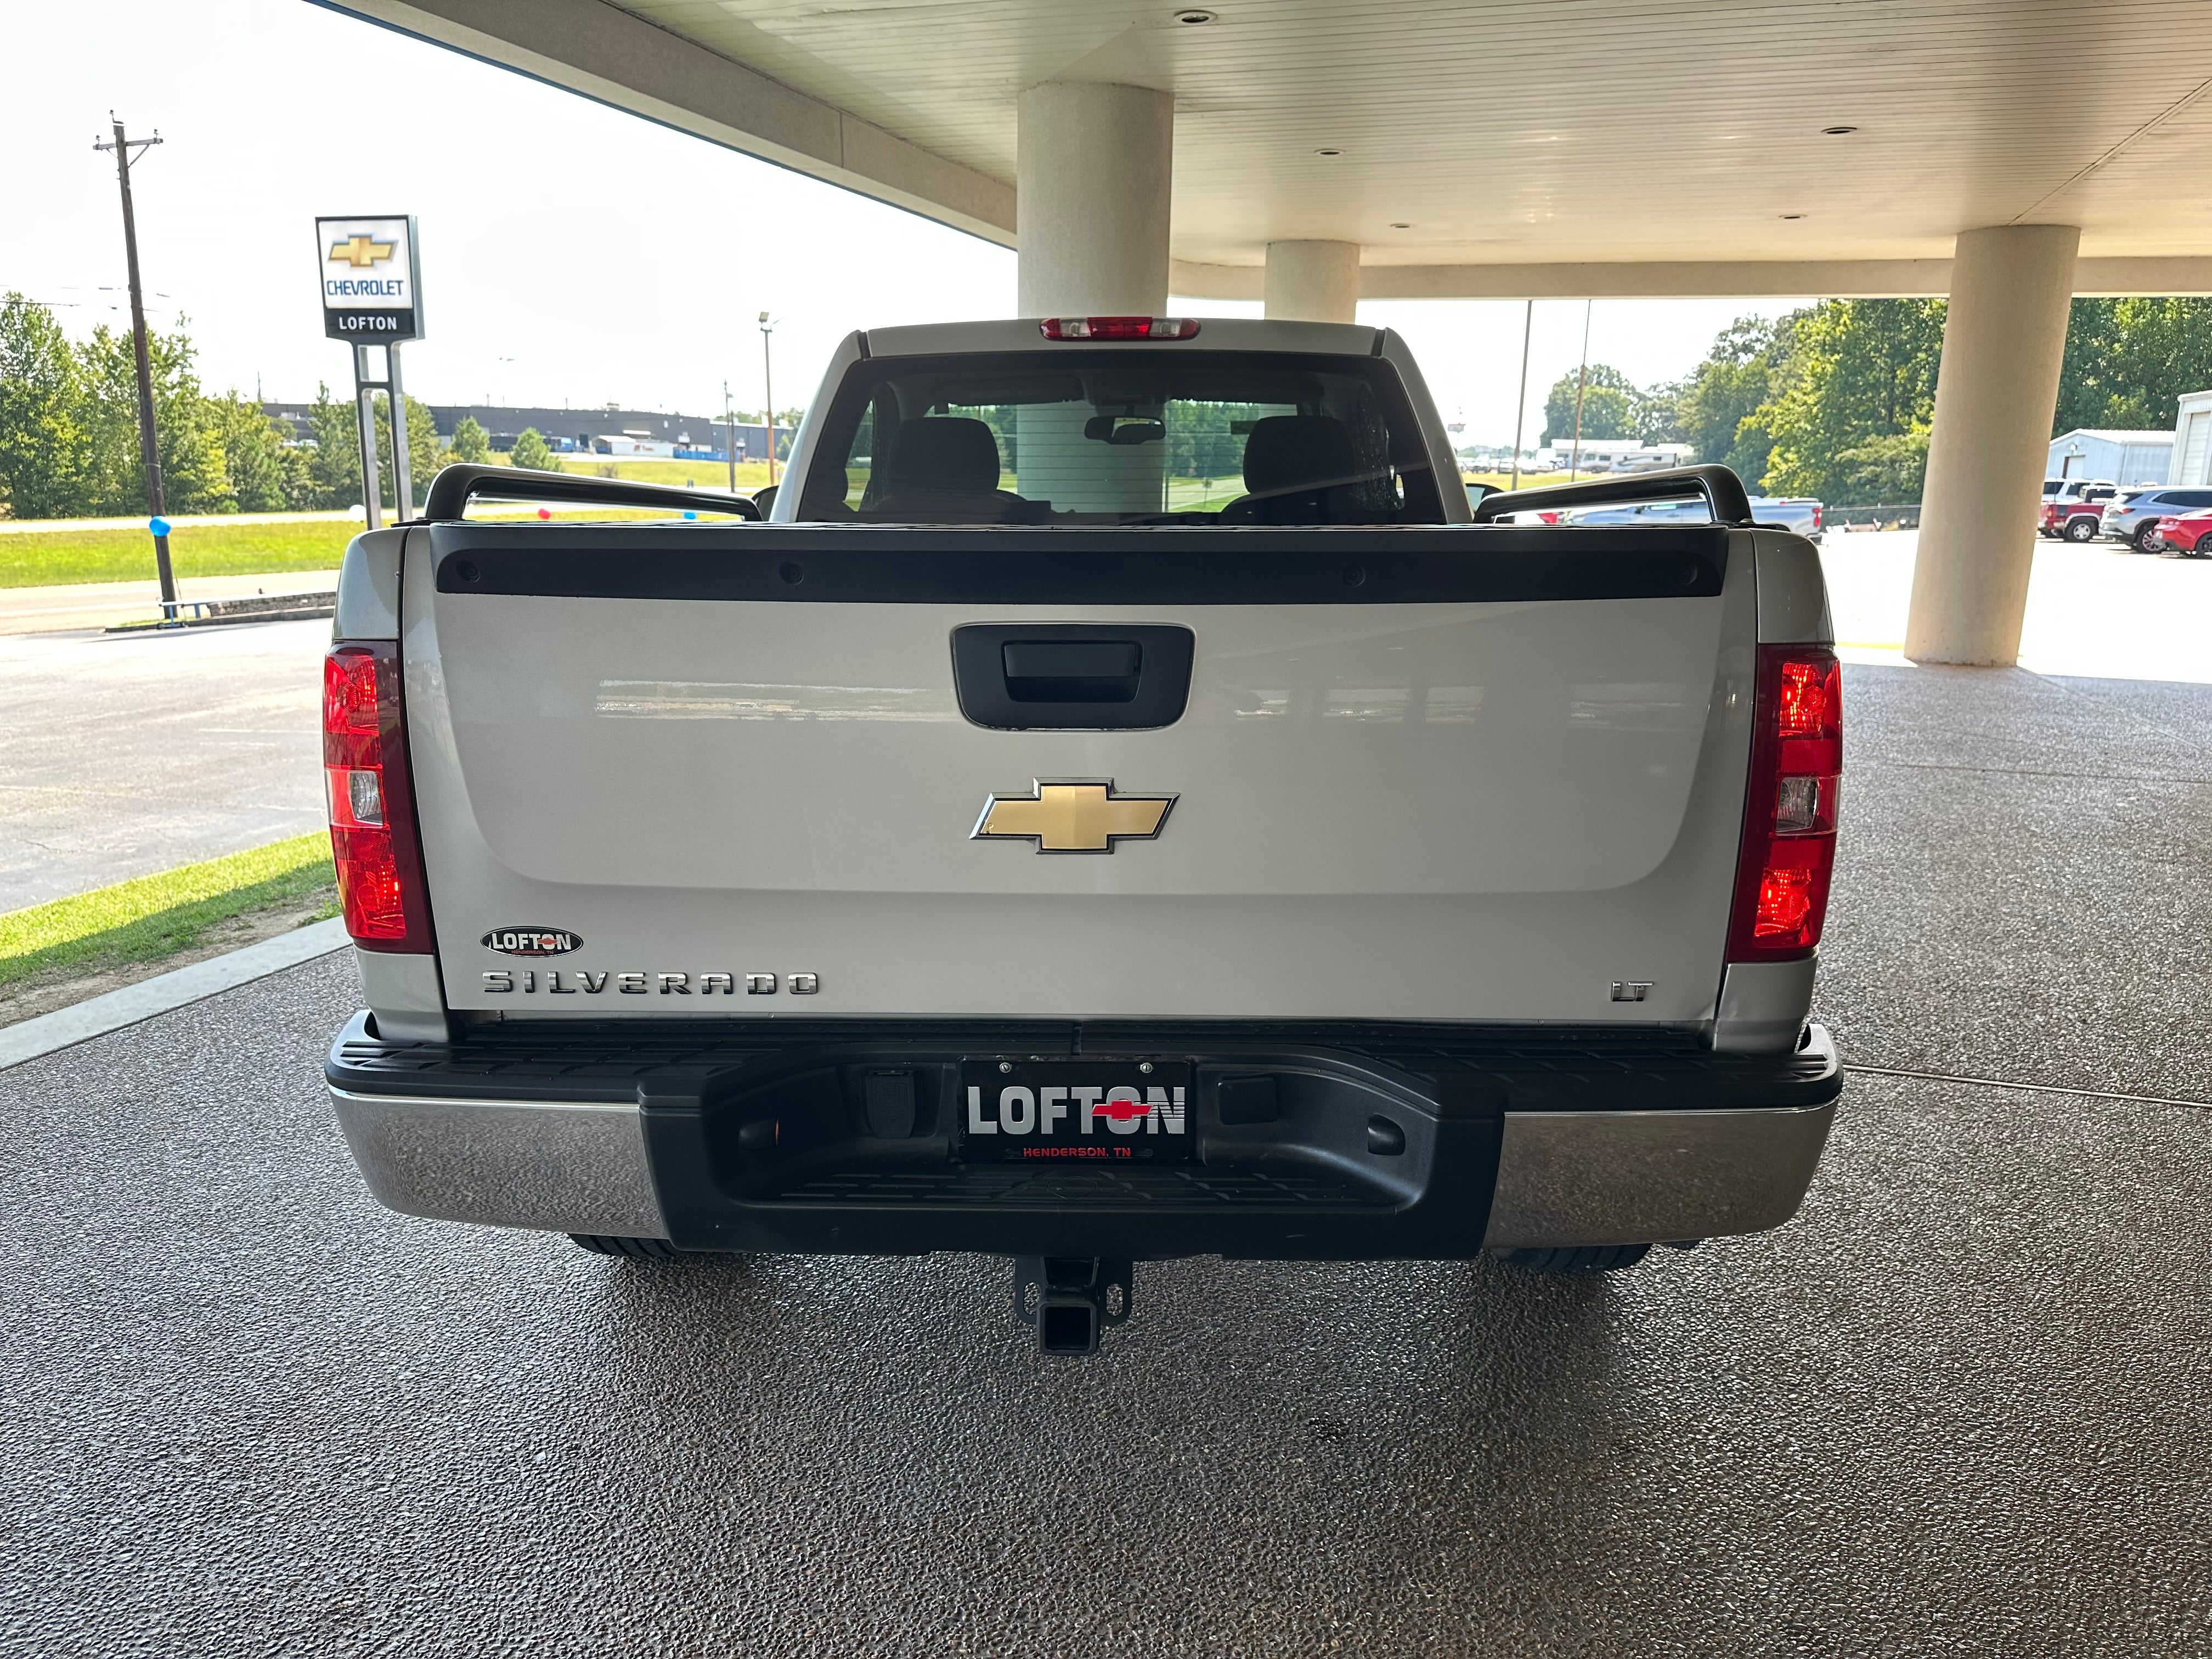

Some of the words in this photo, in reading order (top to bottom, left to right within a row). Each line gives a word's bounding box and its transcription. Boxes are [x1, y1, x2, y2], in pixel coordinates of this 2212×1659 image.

[326, 280, 404, 296] CHEVROLET
[338, 316, 397, 330] LOFTON
[492, 933, 572, 950] LOFTON
[482, 970, 819, 995] SILVERADO
[1611, 981, 1654, 1002] LT
[967, 1086, 1186, 1135] LOFTON
[1023, 1147, 1109, 1158] HENDERSON,
[1113, 1147, 1131, 1157] TN
